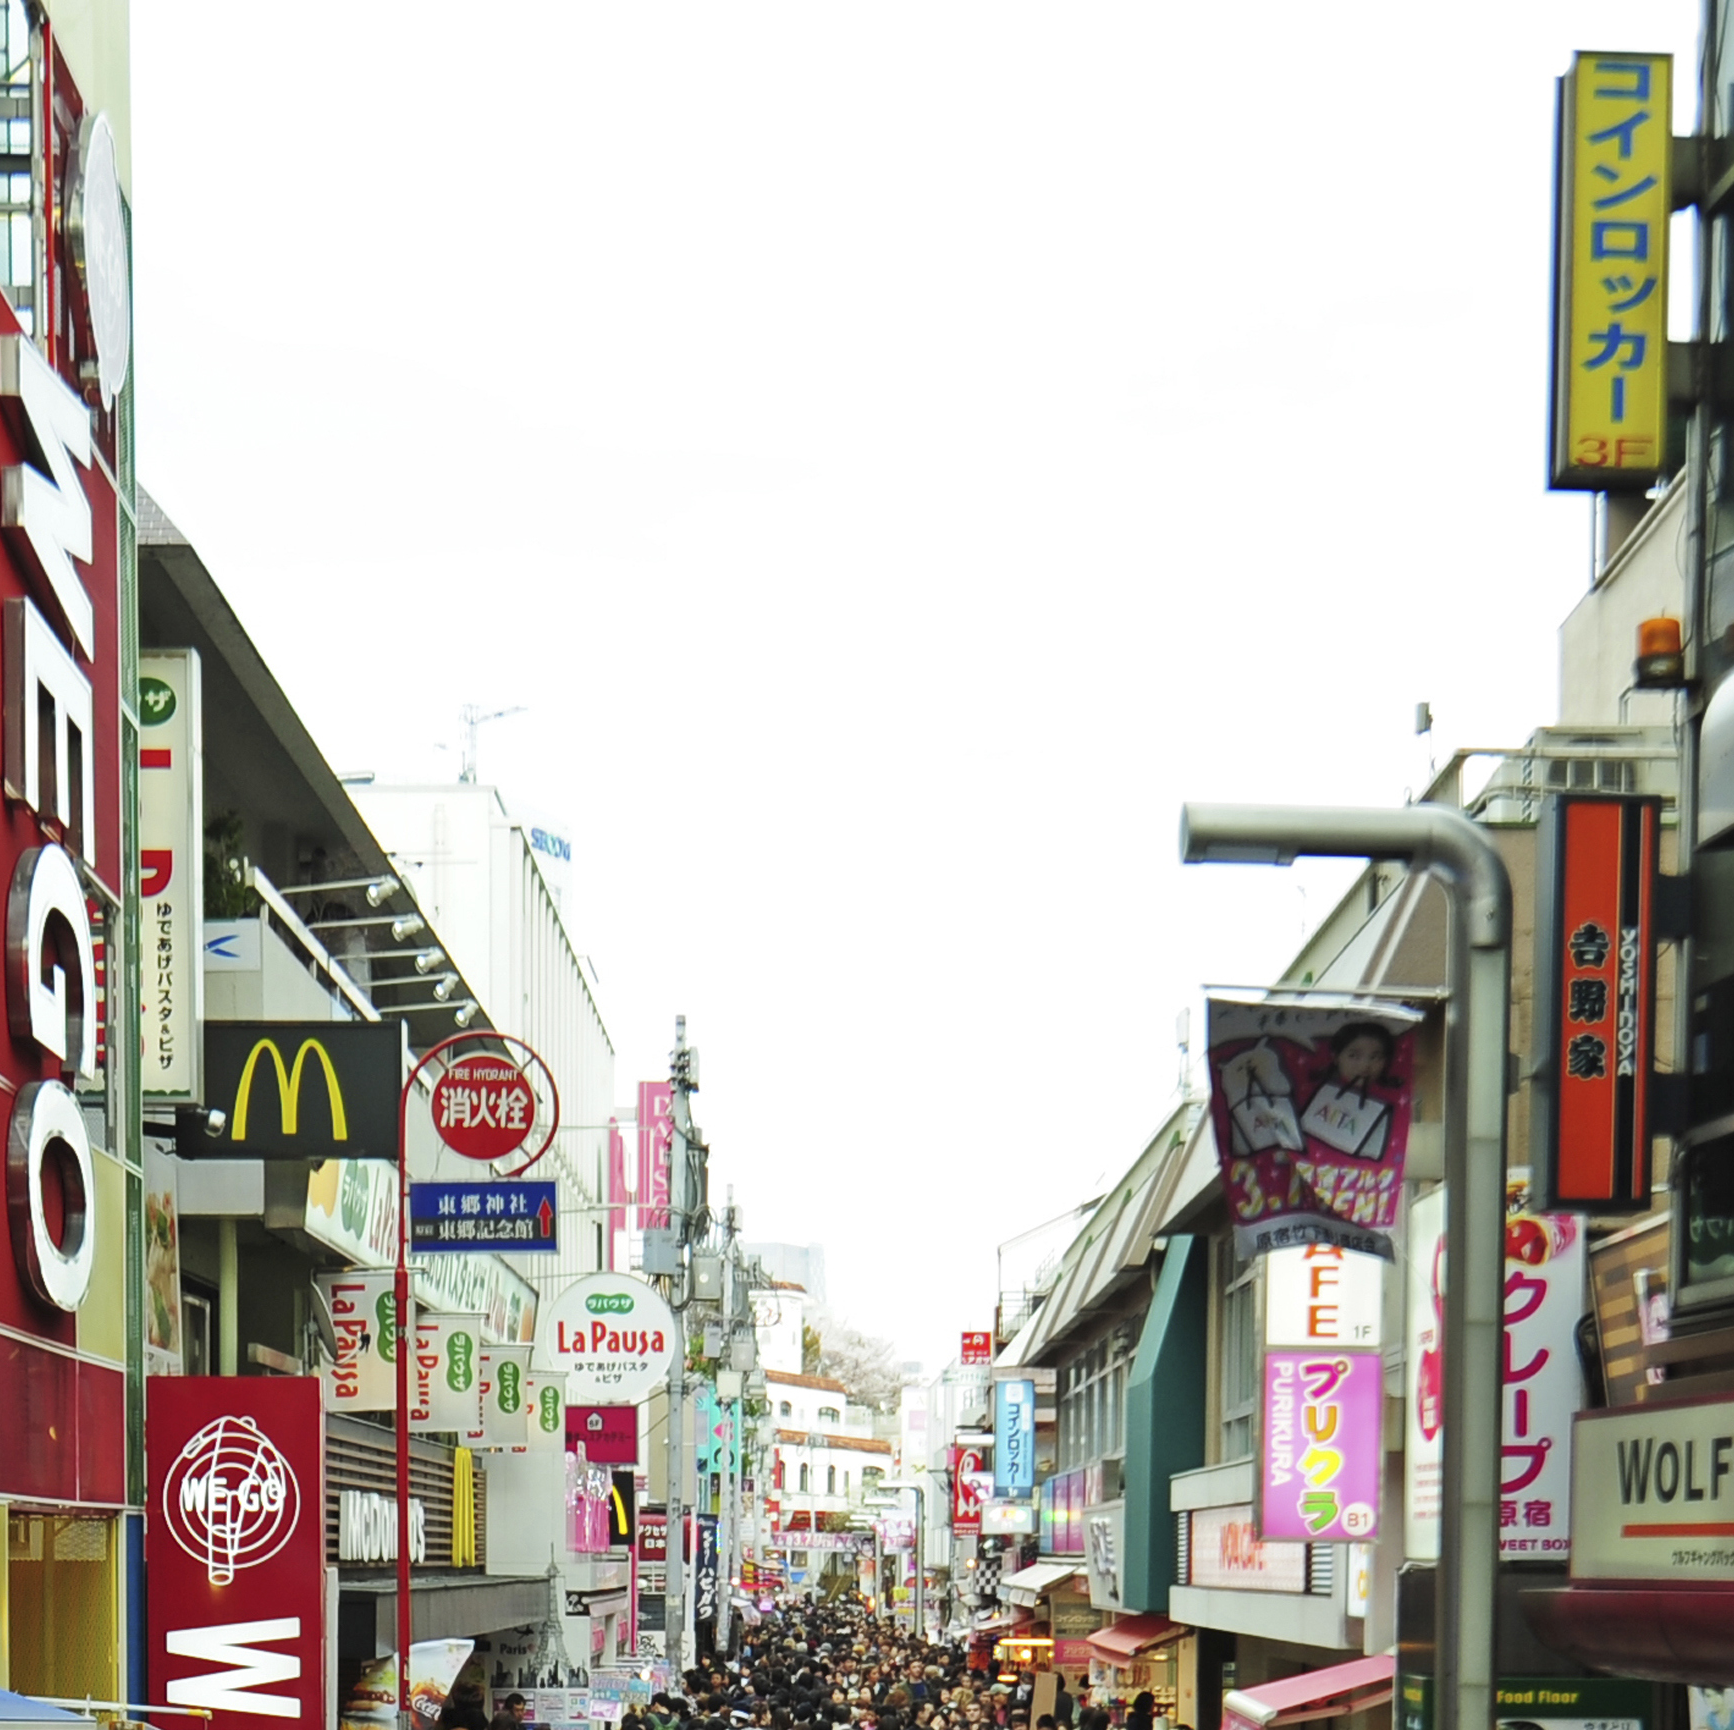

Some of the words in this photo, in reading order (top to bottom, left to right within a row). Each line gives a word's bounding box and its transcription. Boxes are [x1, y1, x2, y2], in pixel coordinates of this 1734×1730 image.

[1582, 62, 1658, 424] コインロッカー
[1575, 437, 1653, 468] 3F
[2, 330, 96, 1312] WEGO
[1618, 928, 1638, 1077] YOSHINOYA
[448, 1068, 470, 1081] FIRE
[473, 1069, 518, 1082] HYDRANT
[440, 1086, 528, 1130] 消火栓
[438, 1193, 528, 1215] 東郷神社
[438, 1219, 533, 1241] 東郷記念館
[331, 1284, 366, 1314] La
[558, 1321, 586, 1354] La
[591, 1321, 664, 1357] Pausa
[1353, 1326, 1371, 1339] 1F
[1270, 1361, 1294, 1486] PURIKURA
[1301, 1360, 1349, 1533] プリクラ
[181, 1478, 228, 1512] WE
[239, 1478, 283, 1513] GO
[1347, 1512, 1369, 1528] B1
[1499, 1499, 1551, 1528] 原宿
[1496, 1690, 1533, 1704] Food
[1538, 1690, 1579, 1704] Floor
